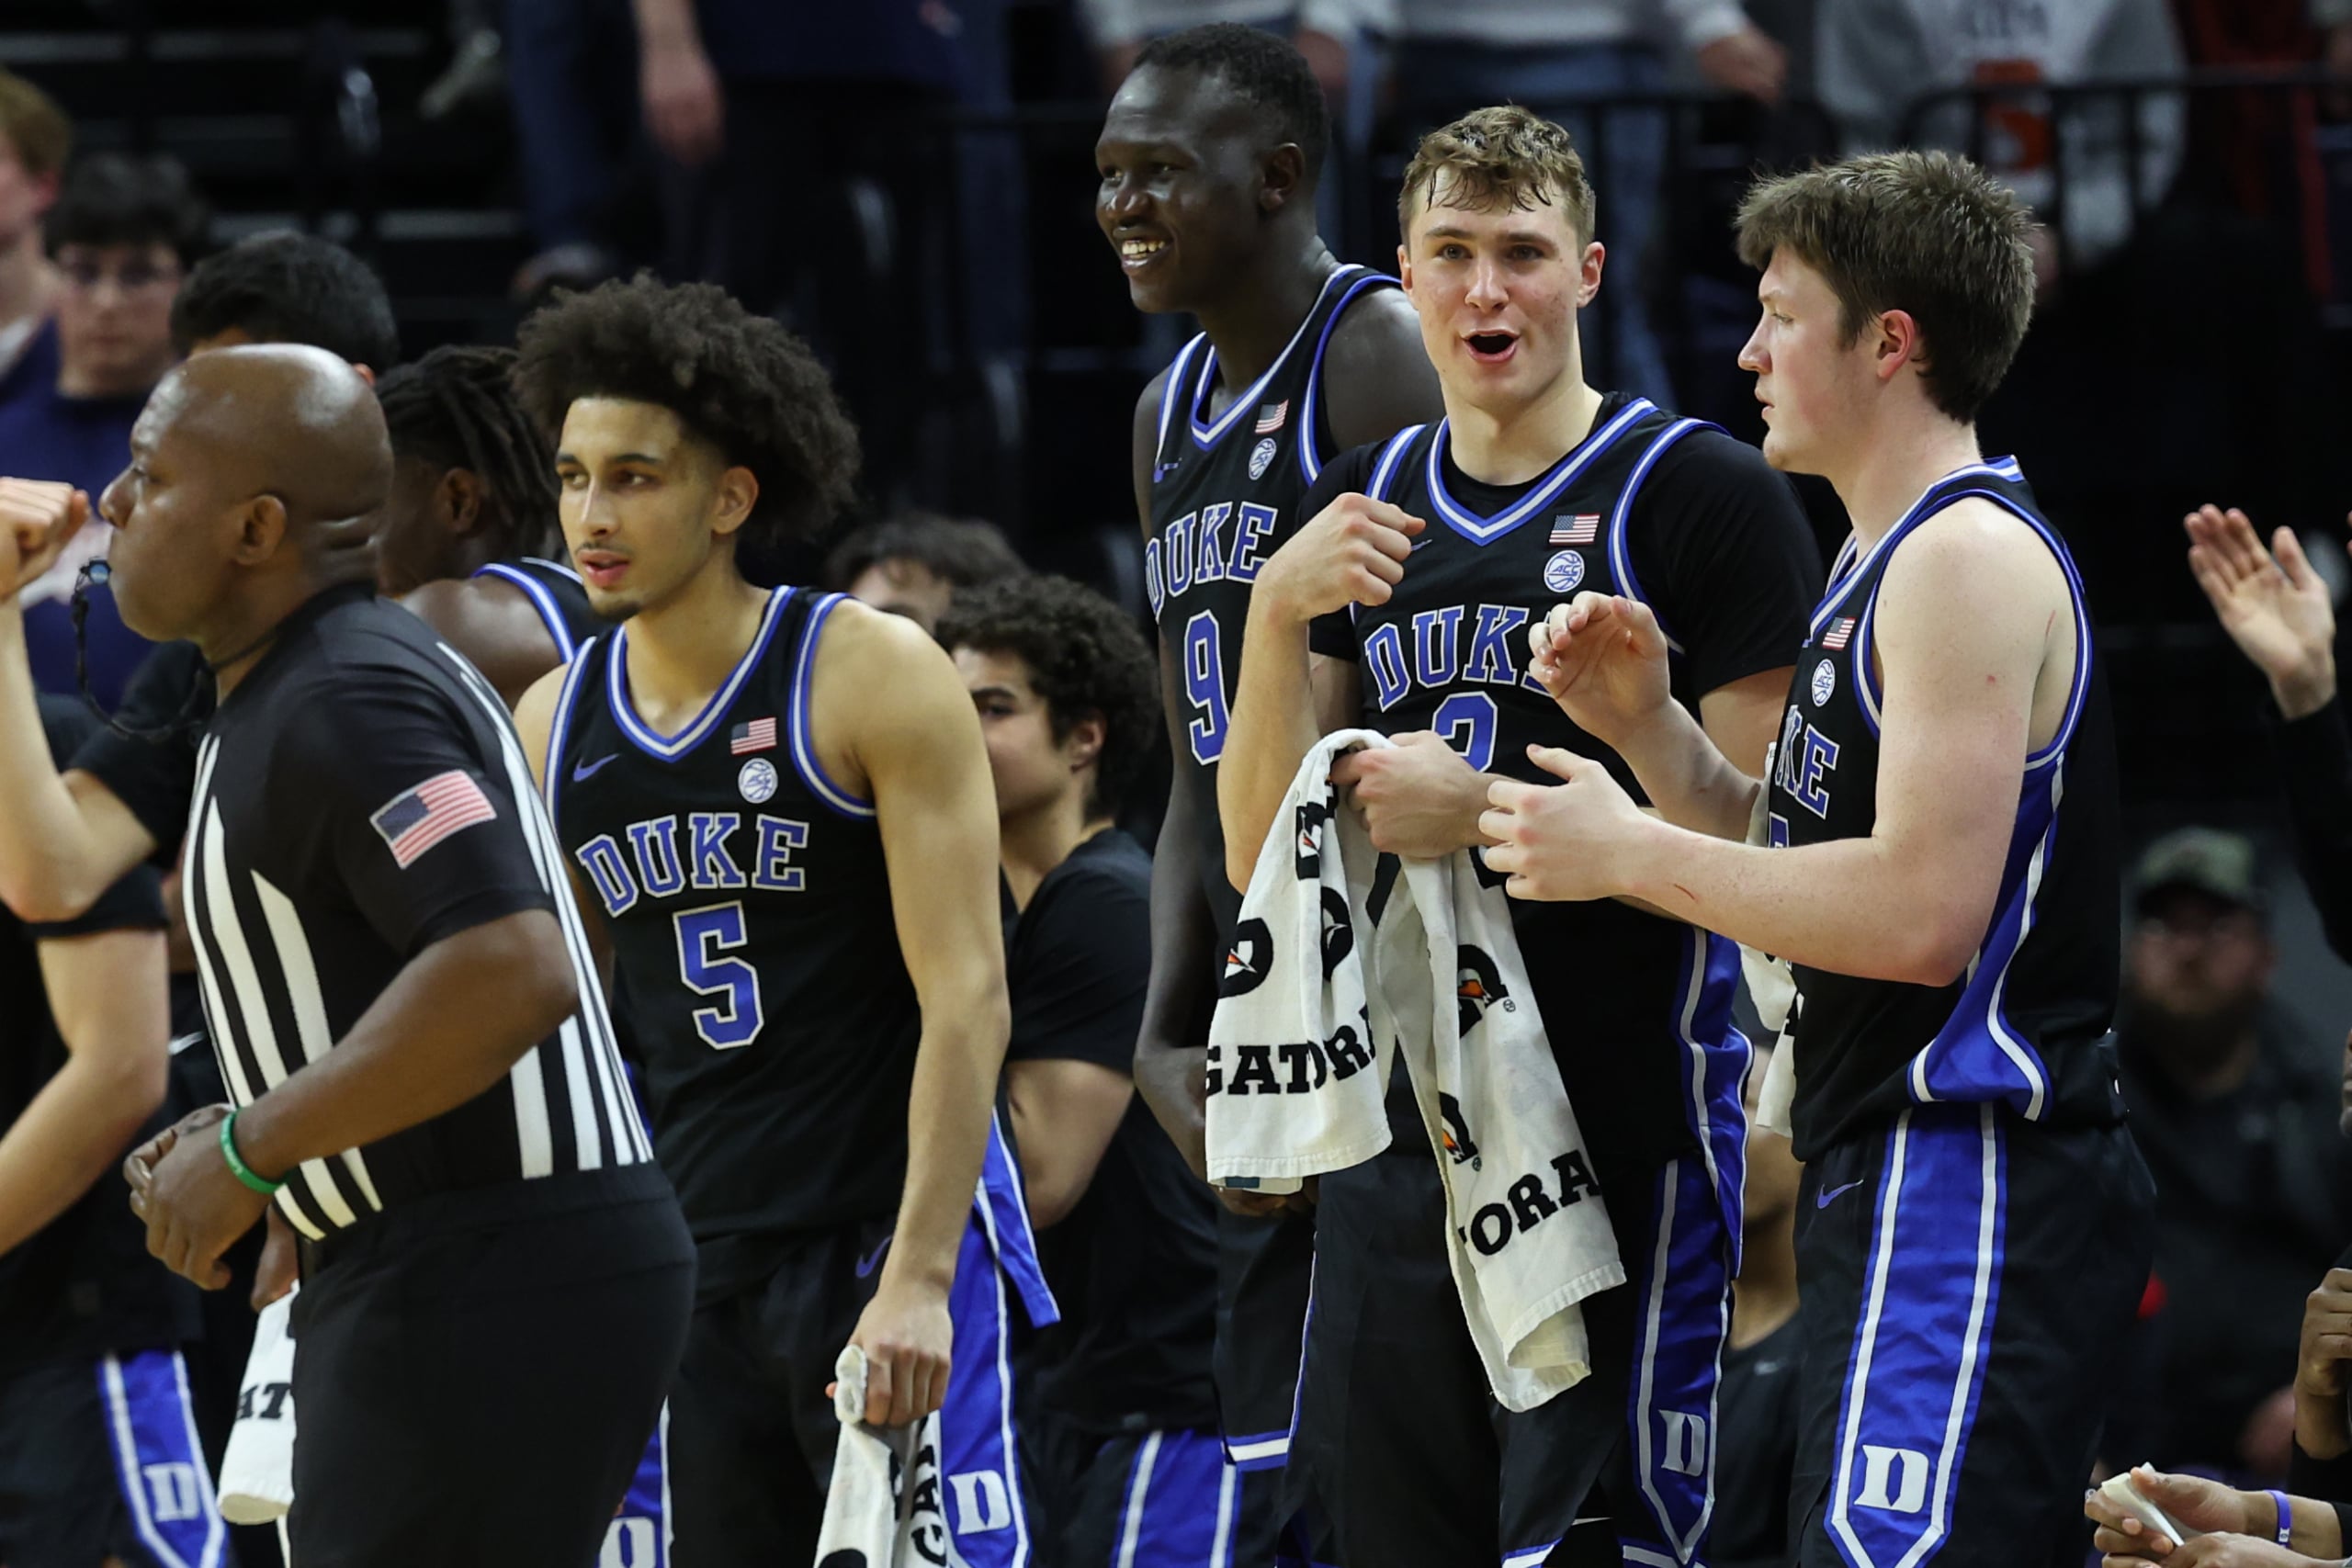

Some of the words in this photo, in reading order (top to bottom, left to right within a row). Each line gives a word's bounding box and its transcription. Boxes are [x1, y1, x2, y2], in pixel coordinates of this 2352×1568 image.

[1145, 501, 1278, 625] DUKE
[1184, 608, 1231, 766] 9
[1364, 603, 1557, 713] DUK
[575, 812, 809, 916] DUKE
[673, 899, 764, 1050] 5
[1206, 1003, 1376, 1098] GATR
[143, 1462, 200, 1522] D
[1657, 1408, 1706, 1477] D
[1854, 1444, 1929, 1514] D
[947, 1470, 1012, 1535] D
